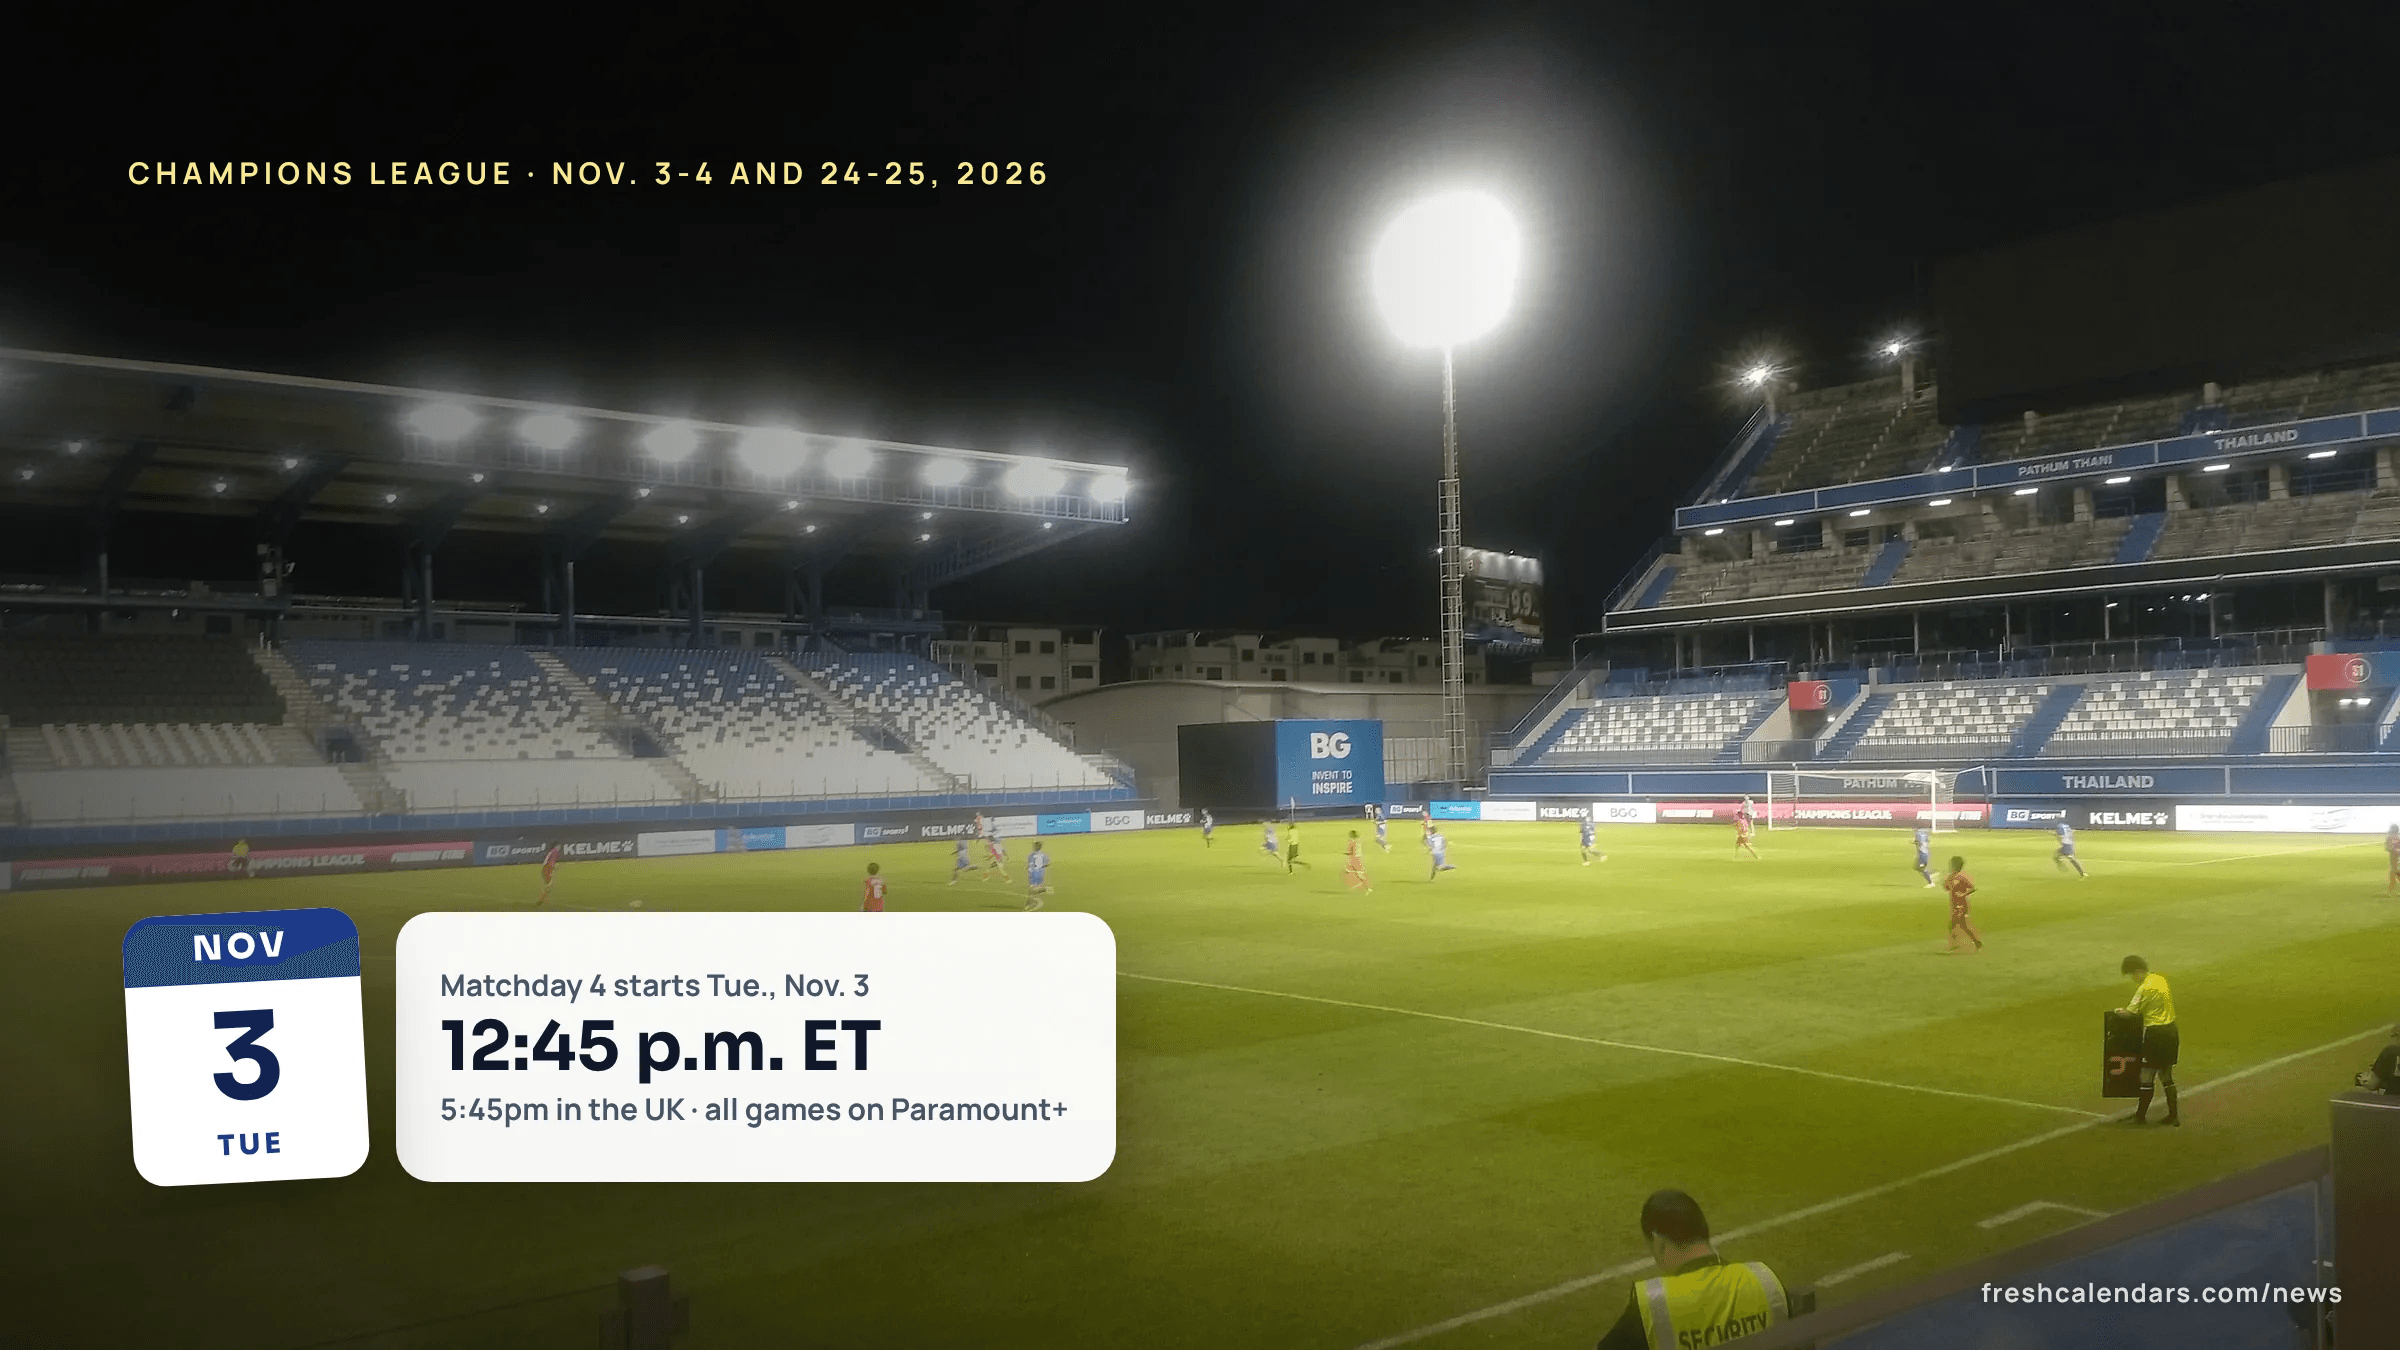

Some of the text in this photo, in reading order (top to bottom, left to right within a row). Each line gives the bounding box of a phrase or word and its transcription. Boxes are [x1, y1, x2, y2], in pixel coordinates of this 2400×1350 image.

[2214, 429, 2299, 450] THAILAND
[2018, 461, 2069, 476] PATHUM
[1310, 732, 1351, 759] BG
[1311, 769, 1353, 780] INVENT TO
[1312, 781, 1353, 795] INSPIRE
[1842, 777, 1898, 788] PATHUM
[2062, 775, 2155, 789] THAILAND
[1146, 813, 1183, 825] KELME
[1540, 807, 1580, 818] KELME
[2089, 812, 2154, 825] KELME
[1105, 815, 1131, 826] BGC
[563, 841, 621, 855] KELME
[1679, 1311, 1768, 1350] SECURITY
